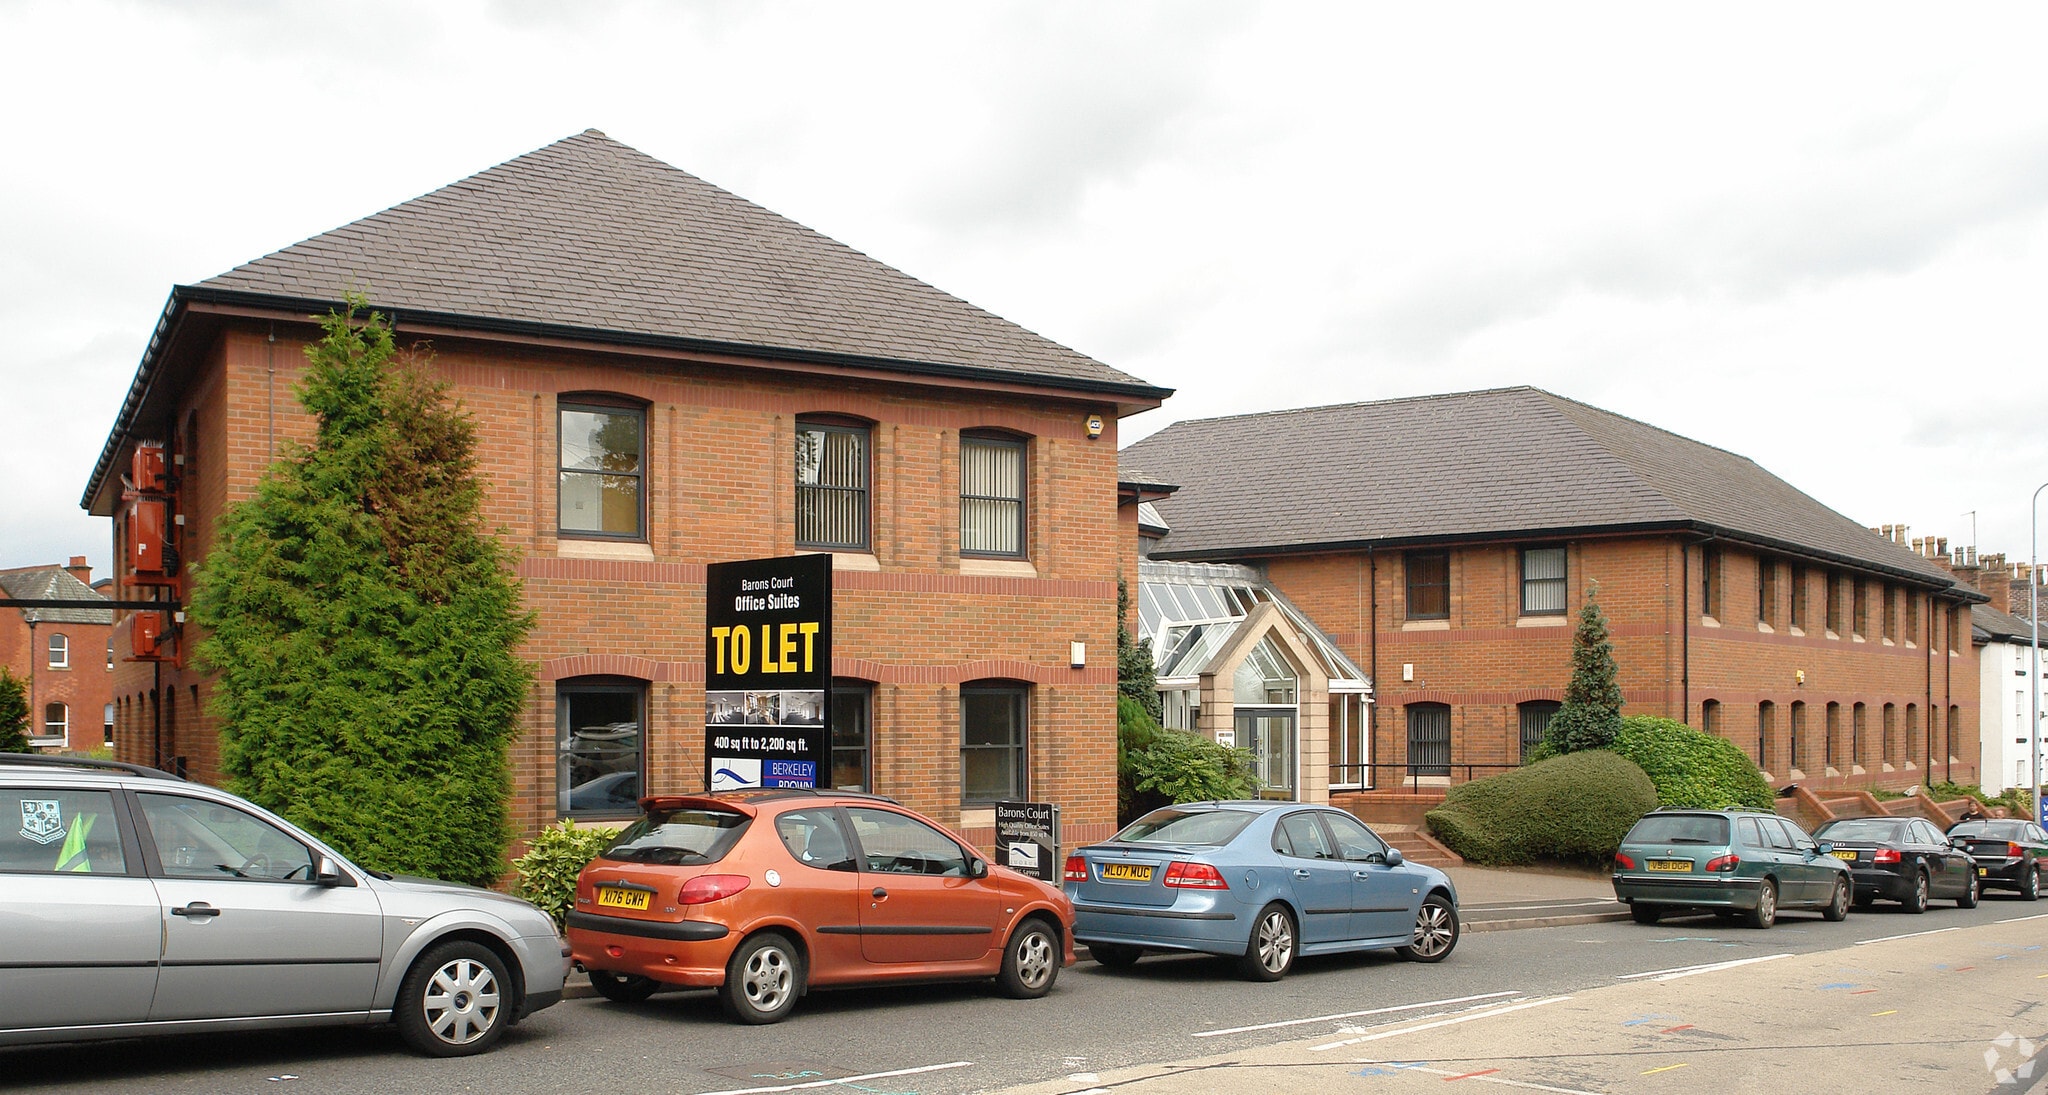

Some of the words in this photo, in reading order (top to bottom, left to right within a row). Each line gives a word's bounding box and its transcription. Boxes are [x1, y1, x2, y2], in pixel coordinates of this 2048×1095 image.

[742, 578, 769, 591] Barons
[771, 576, 794, 589] Court
[735, 595, 766, 612] Office
[768, 593, 800, 610] Suites
[712, 624, 751, 675] TO
[761, 622, 819, 674] LET
[714, 736, 729, 749] 400
[730, 739, 740, 752] sq
[742, 737, 749, 749] ft
[750, 737, 760, 750] to
[760, 737, 785, 752] 2,200
[786, 740, 797, 753] sq
[798, 738, 809, 751] ft.
[772, 762, 813, 776] BERKELEY
[998, 806, 1025, 818] Barons
[1027, 807, 1050, 819] Court
[998, 821, 1009, 830] High
[1009, 822, 1024, 830] Quality
[1104, 863, 1128, 876] ML07
[1130, 865, 1150, 878] MUC
[603, 889, 623, 904] X176
[625, 891, 645, 906] GWH
